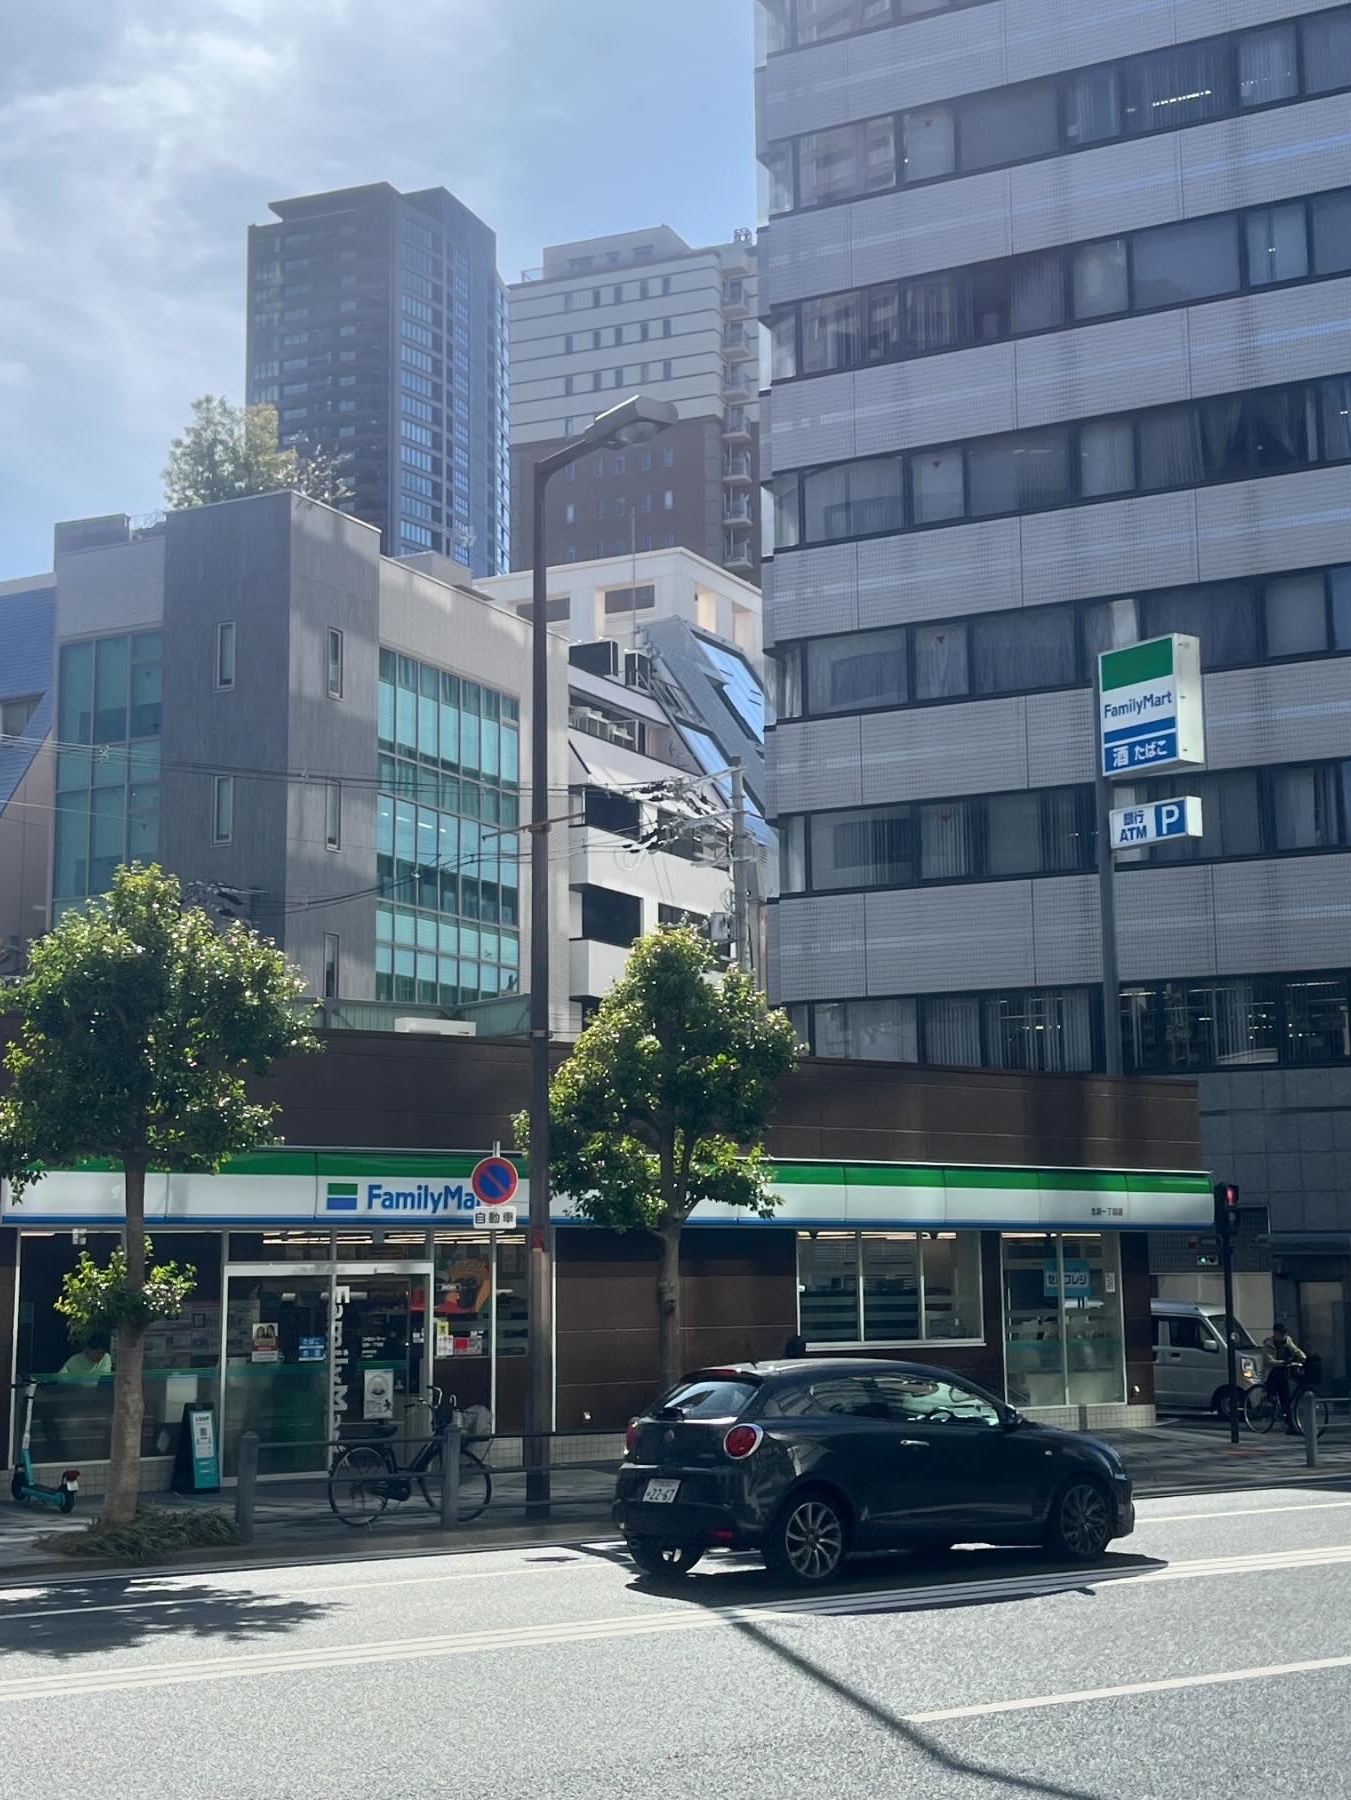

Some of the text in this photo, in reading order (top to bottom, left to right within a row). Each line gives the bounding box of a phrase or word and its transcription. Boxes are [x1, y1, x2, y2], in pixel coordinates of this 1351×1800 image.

[1104, 690, 1172, 720] FamilyMart
[1112, 740, 1168, 767] 酒 たばこ
[1161, 804, 1180, 835] P
[1119, 826, 1147, 842] ATM
[367, 1184, 480, 1214] FamilyMa
[475, 1212, 514, 1224] 自動車
